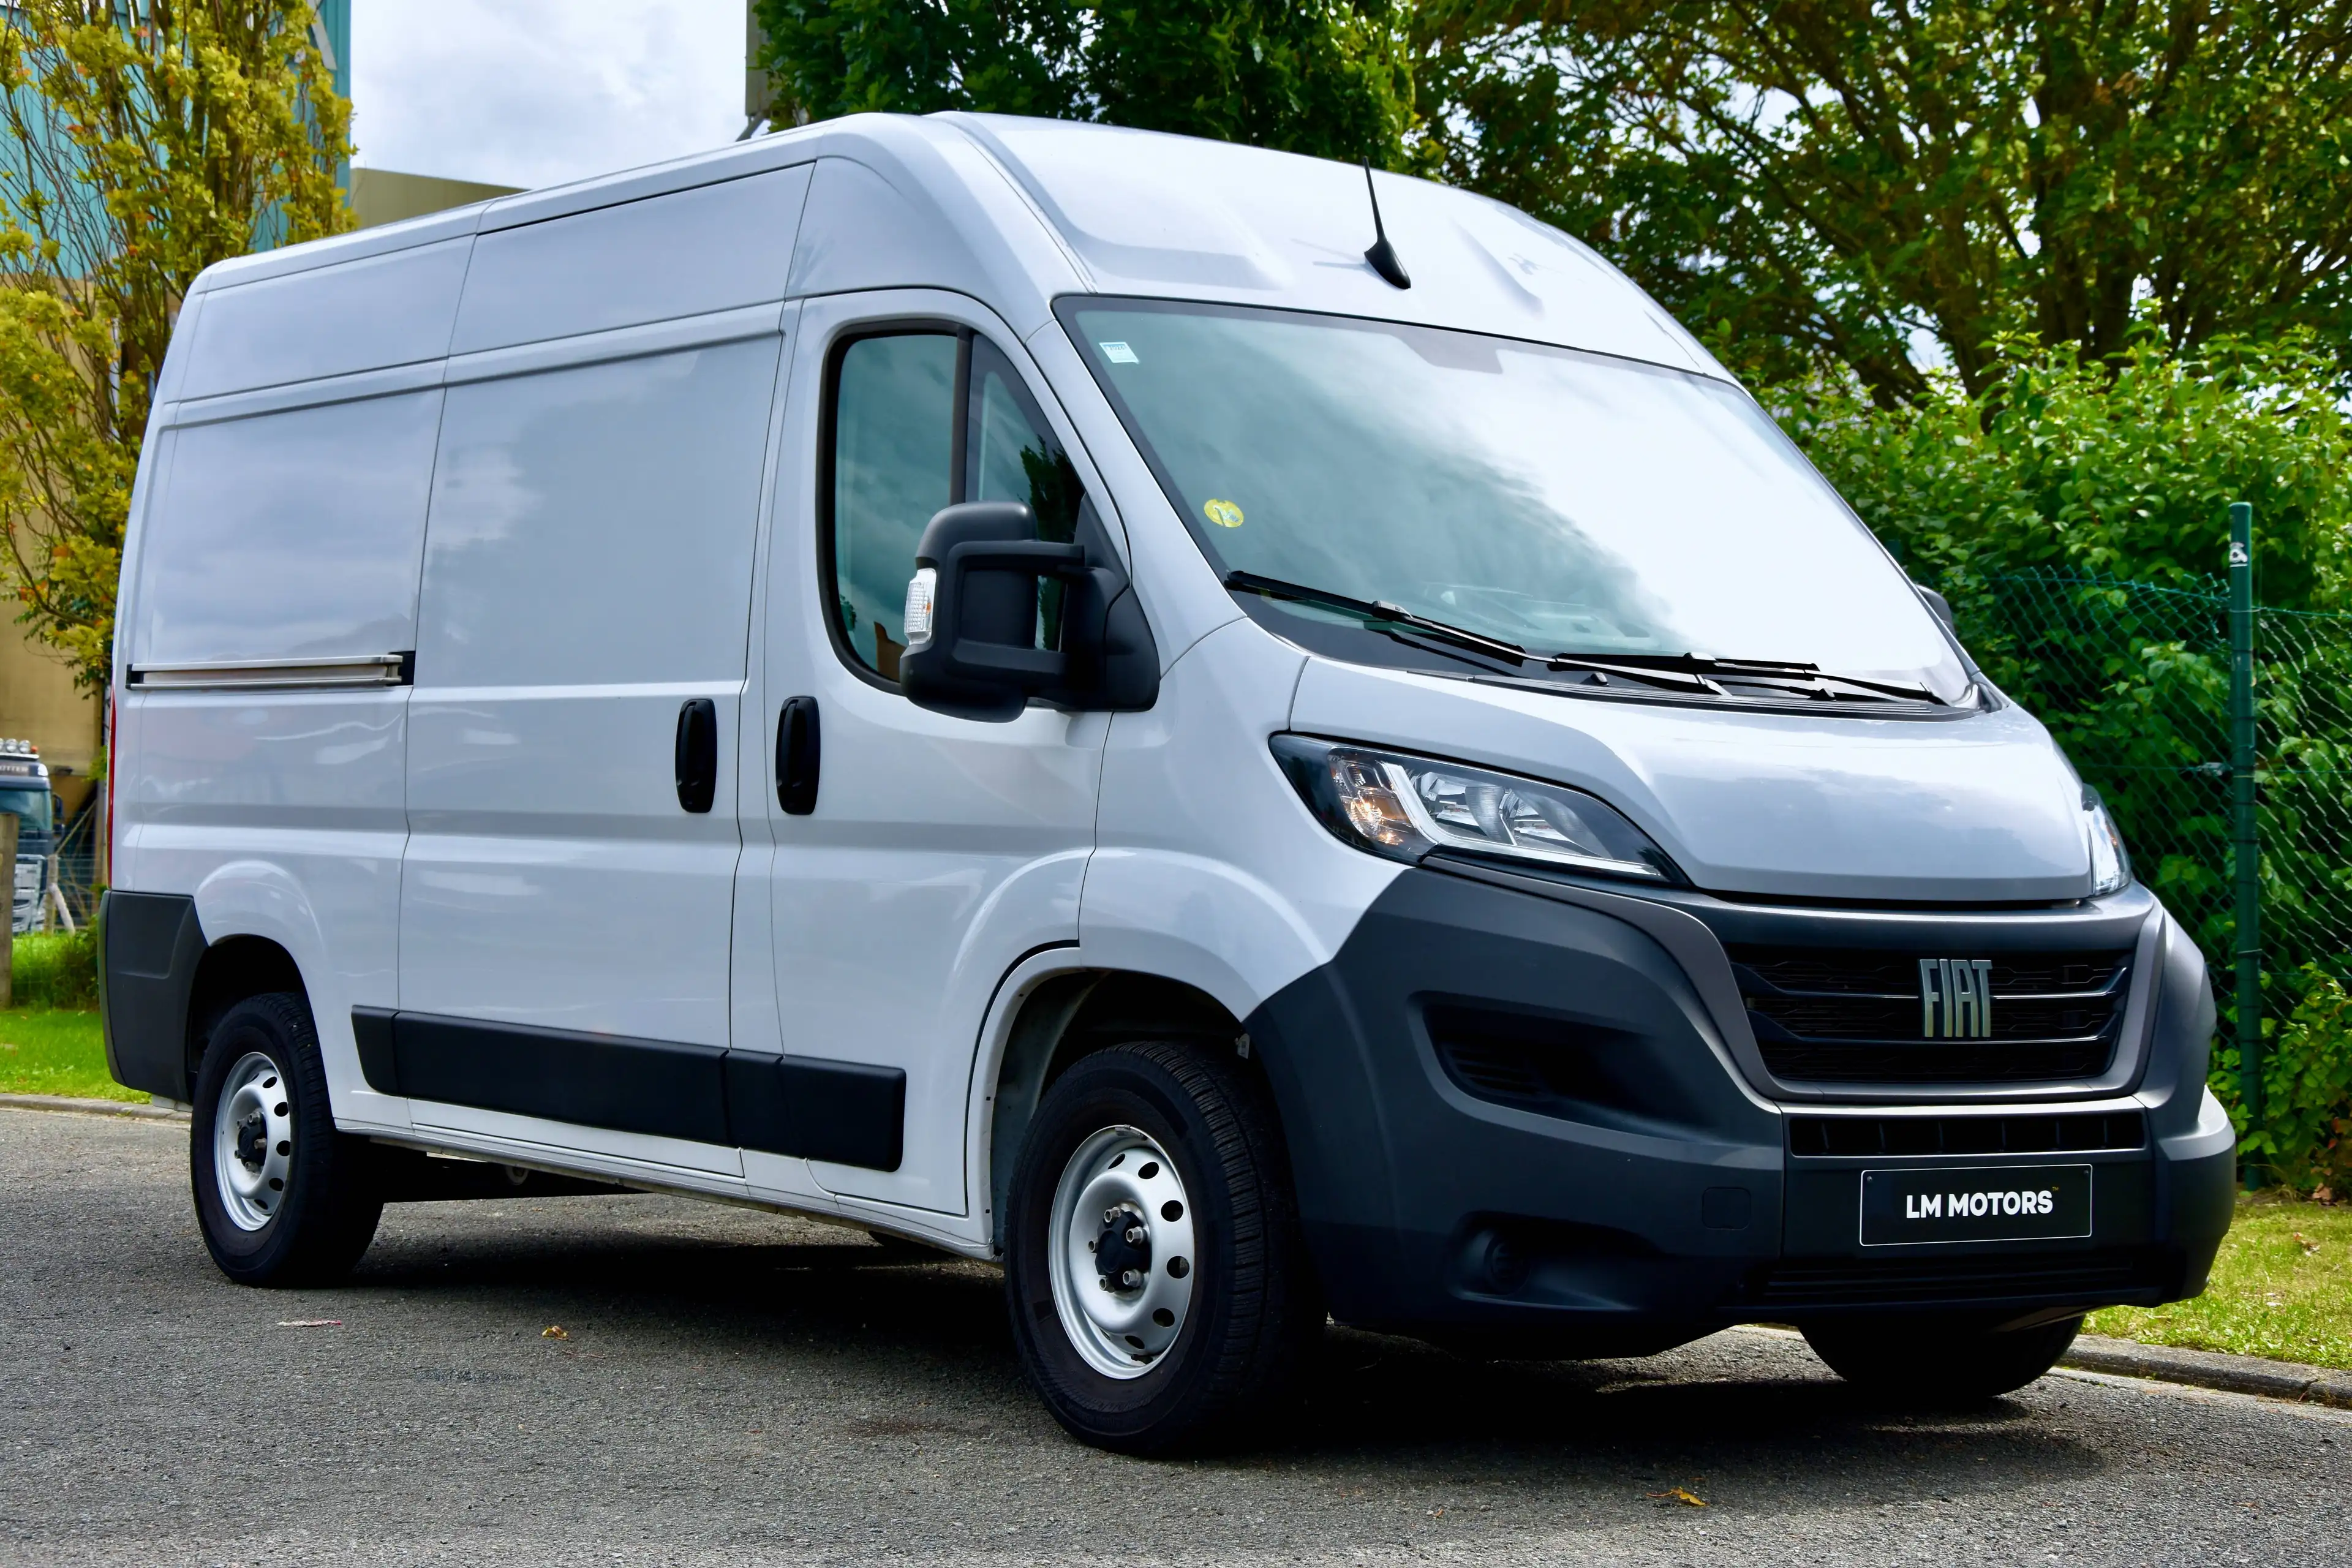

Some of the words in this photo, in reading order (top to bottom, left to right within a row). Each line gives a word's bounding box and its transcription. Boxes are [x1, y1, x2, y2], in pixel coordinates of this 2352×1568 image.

[1920, 959, 1992, 1038] FIAT
[1907, 1194, 1941, 1218] LM
[1948, 1190, 2053, 1217] MOTORS
